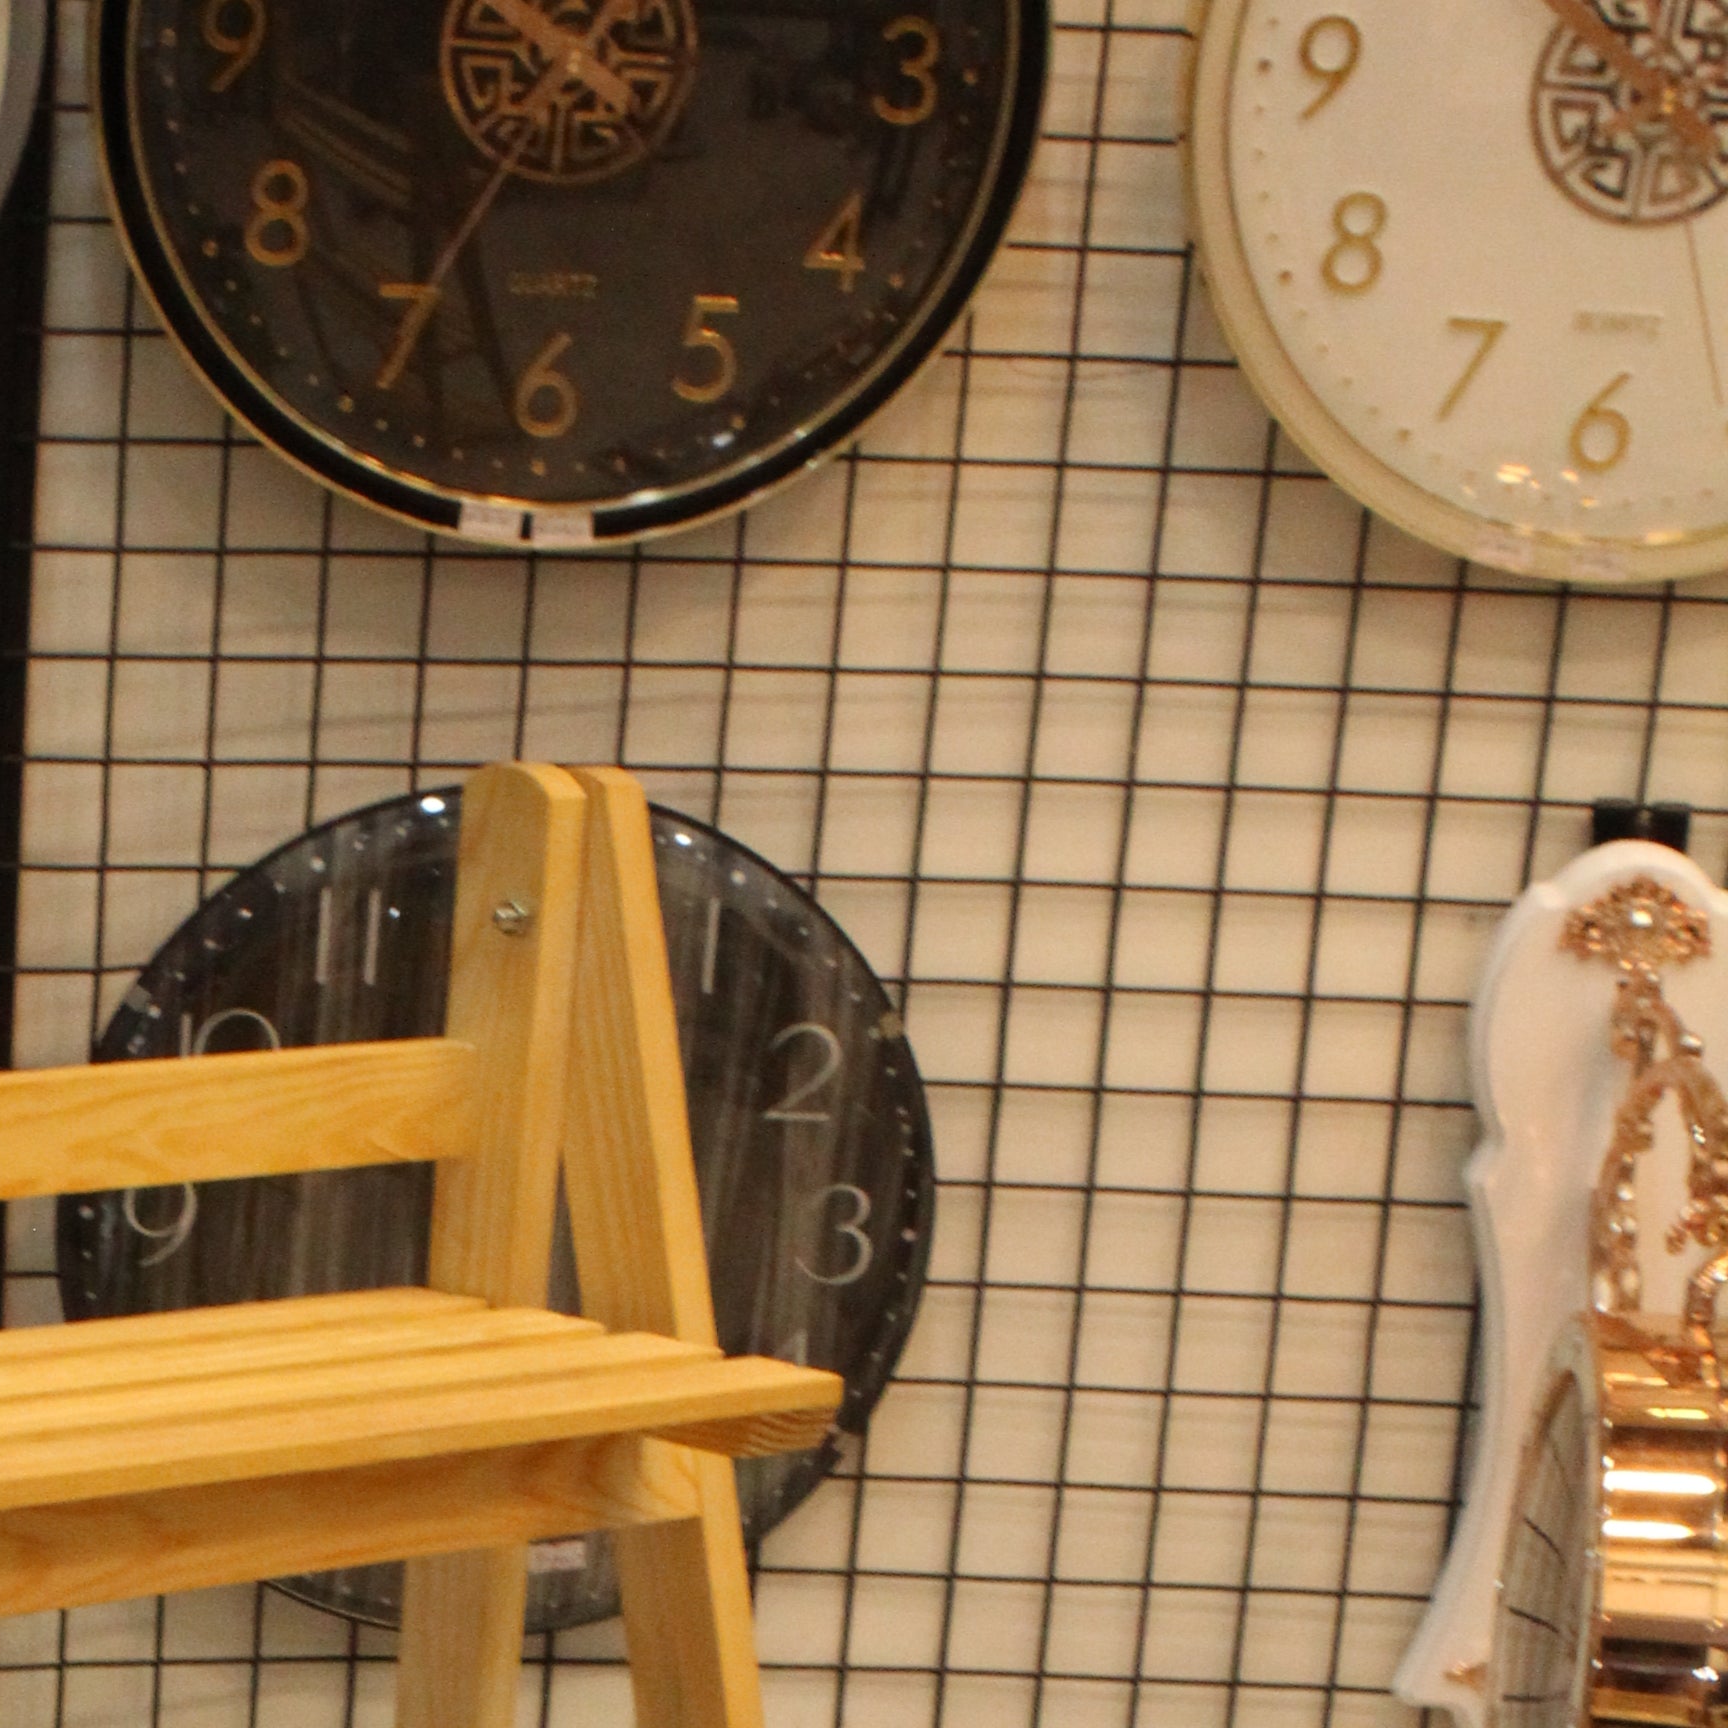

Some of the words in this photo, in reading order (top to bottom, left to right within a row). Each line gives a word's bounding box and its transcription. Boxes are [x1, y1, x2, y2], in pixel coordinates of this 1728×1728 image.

[202, 0, 266, 93] 9
[874, 17, 940, 125] 3
[1299, 15, 1361, 120] 9
[244, 160, 309, 267] 8
[803, 190, 865, 293] 4
[1322, 192, 1387, 295] 8
[375, 284, 439, 389] 7
[515, 333, 578, 438] 6
[672, 296, 739, 401] 5
[1436, 317, 1508, 422] 7
[1571, 372, 1632, 472] 6
[315, 886, 382, 987] 11
[764, 1022, 843, 1122] 2
[795, 1184, 872, 1285] 3
